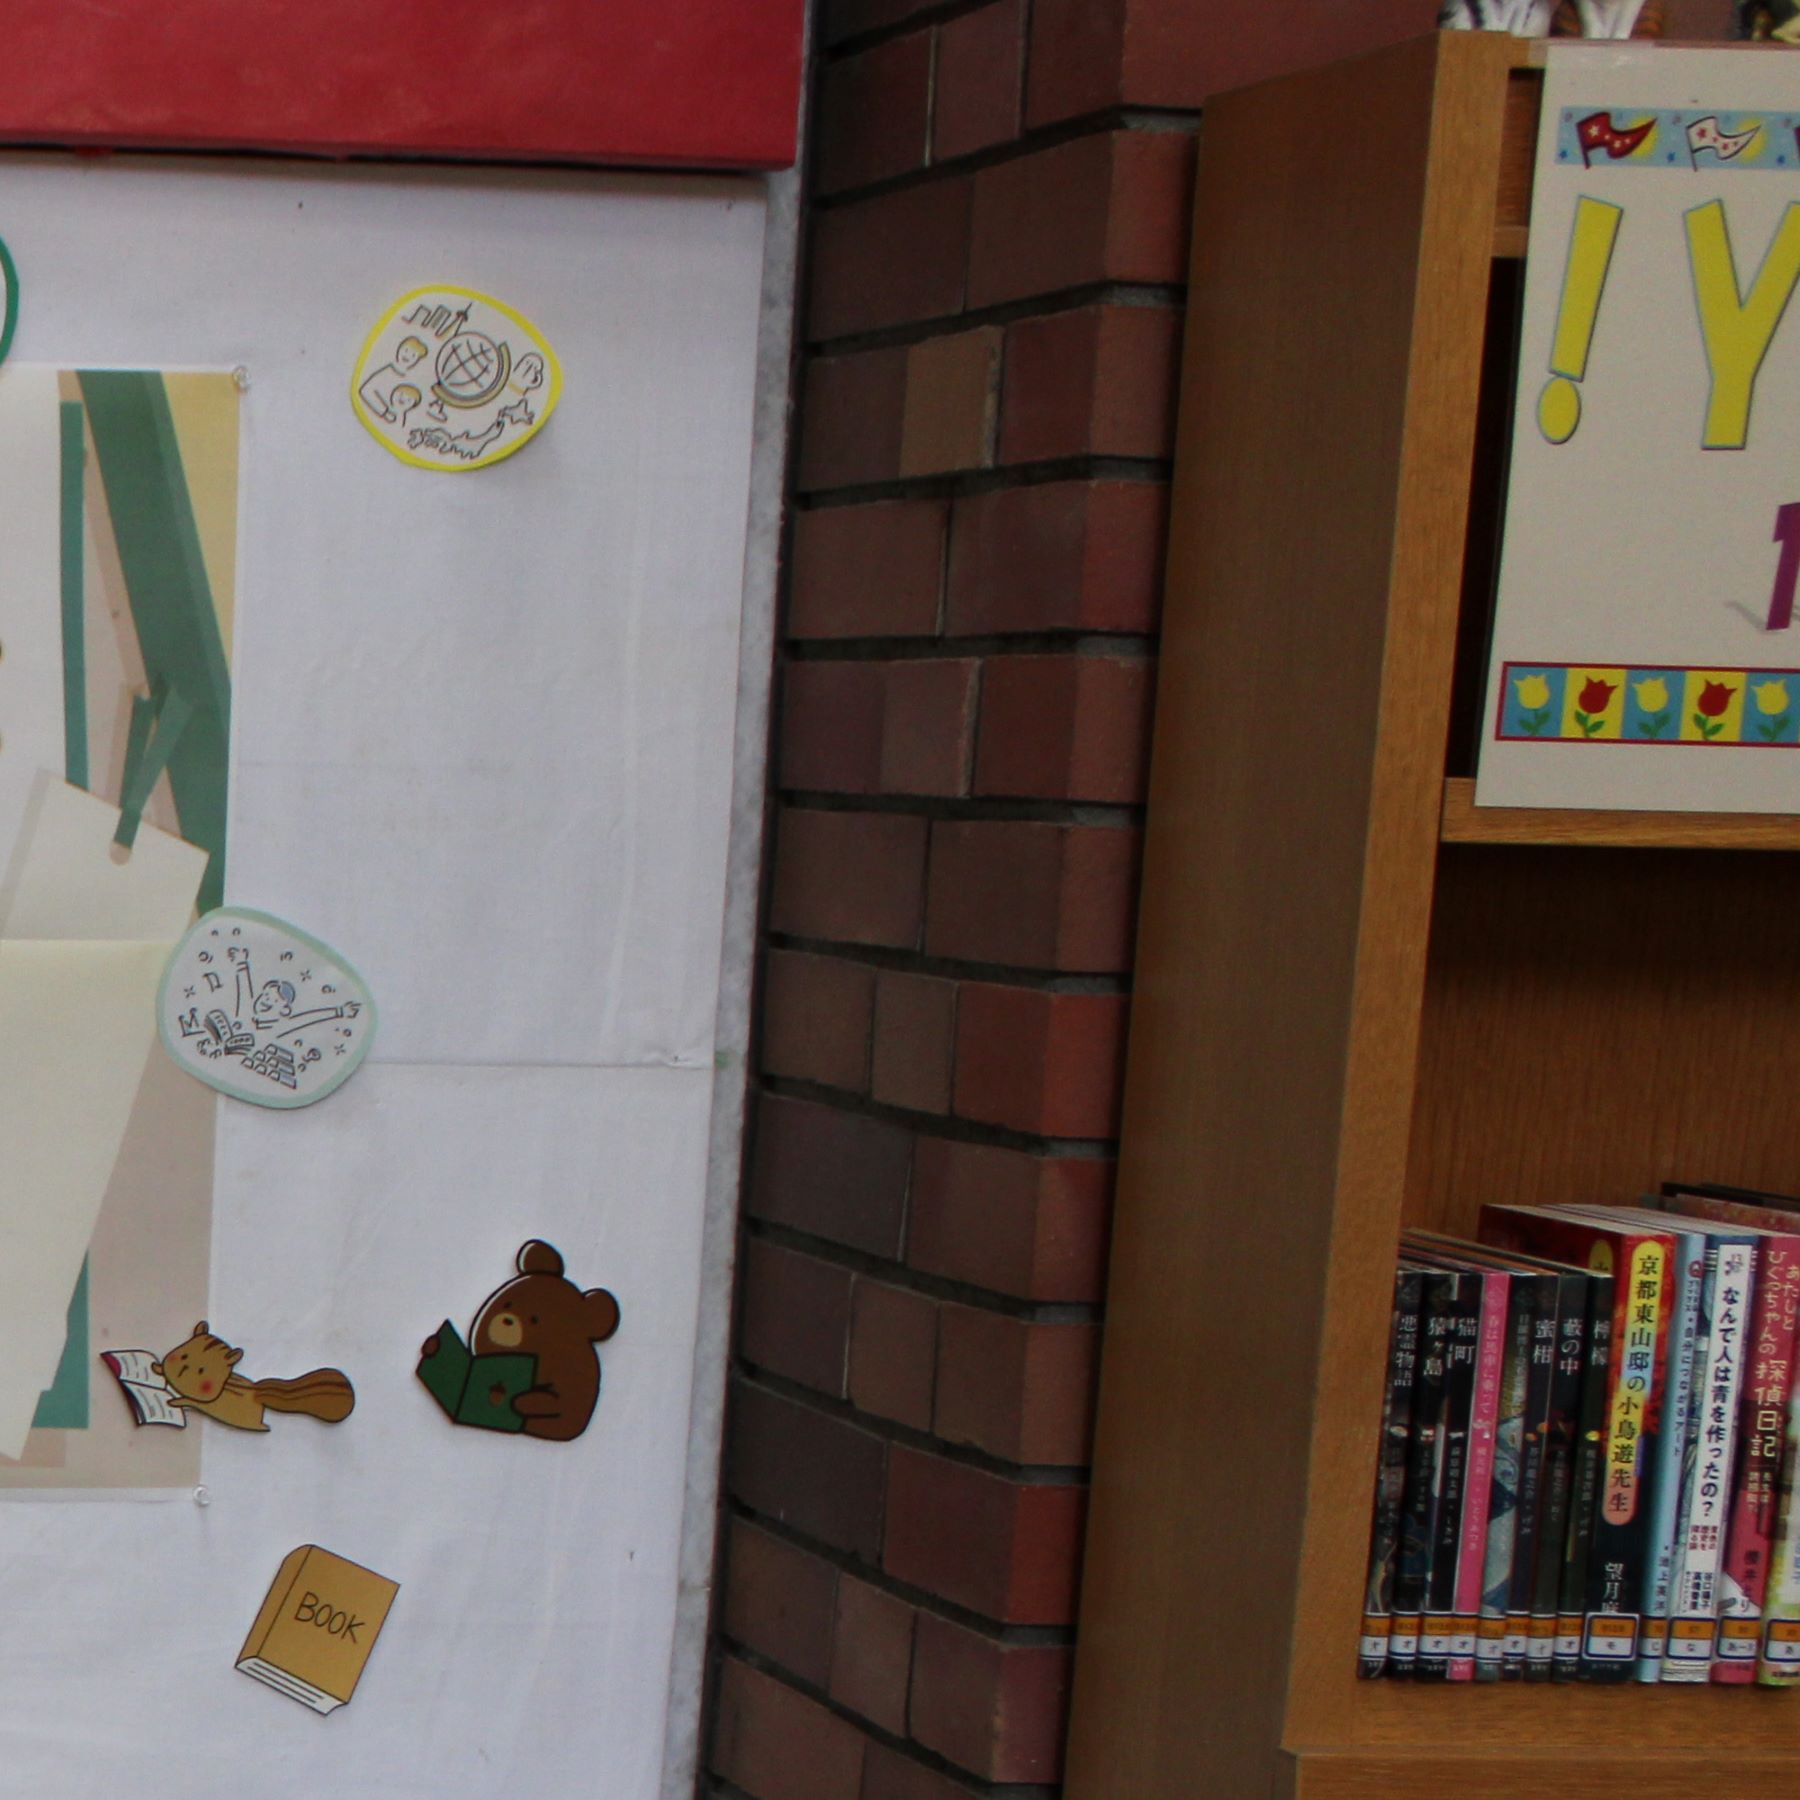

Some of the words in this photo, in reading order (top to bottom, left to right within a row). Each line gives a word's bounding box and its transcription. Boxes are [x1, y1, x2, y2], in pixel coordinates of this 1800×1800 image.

[1455, 1318, 1477, 1366] 猫町
[1533, 1319, 1556, 1365] 蜜柑
[1560, 1317, 1584, 1376] 藪の中
[1609, 1253, 1660, 1514] 京都東山邸の小鳥遊先生
[1700, 1286, 1741, 1517] なんで人は青を作ったの?
[294, 1592, 366, 1645] BOOK
